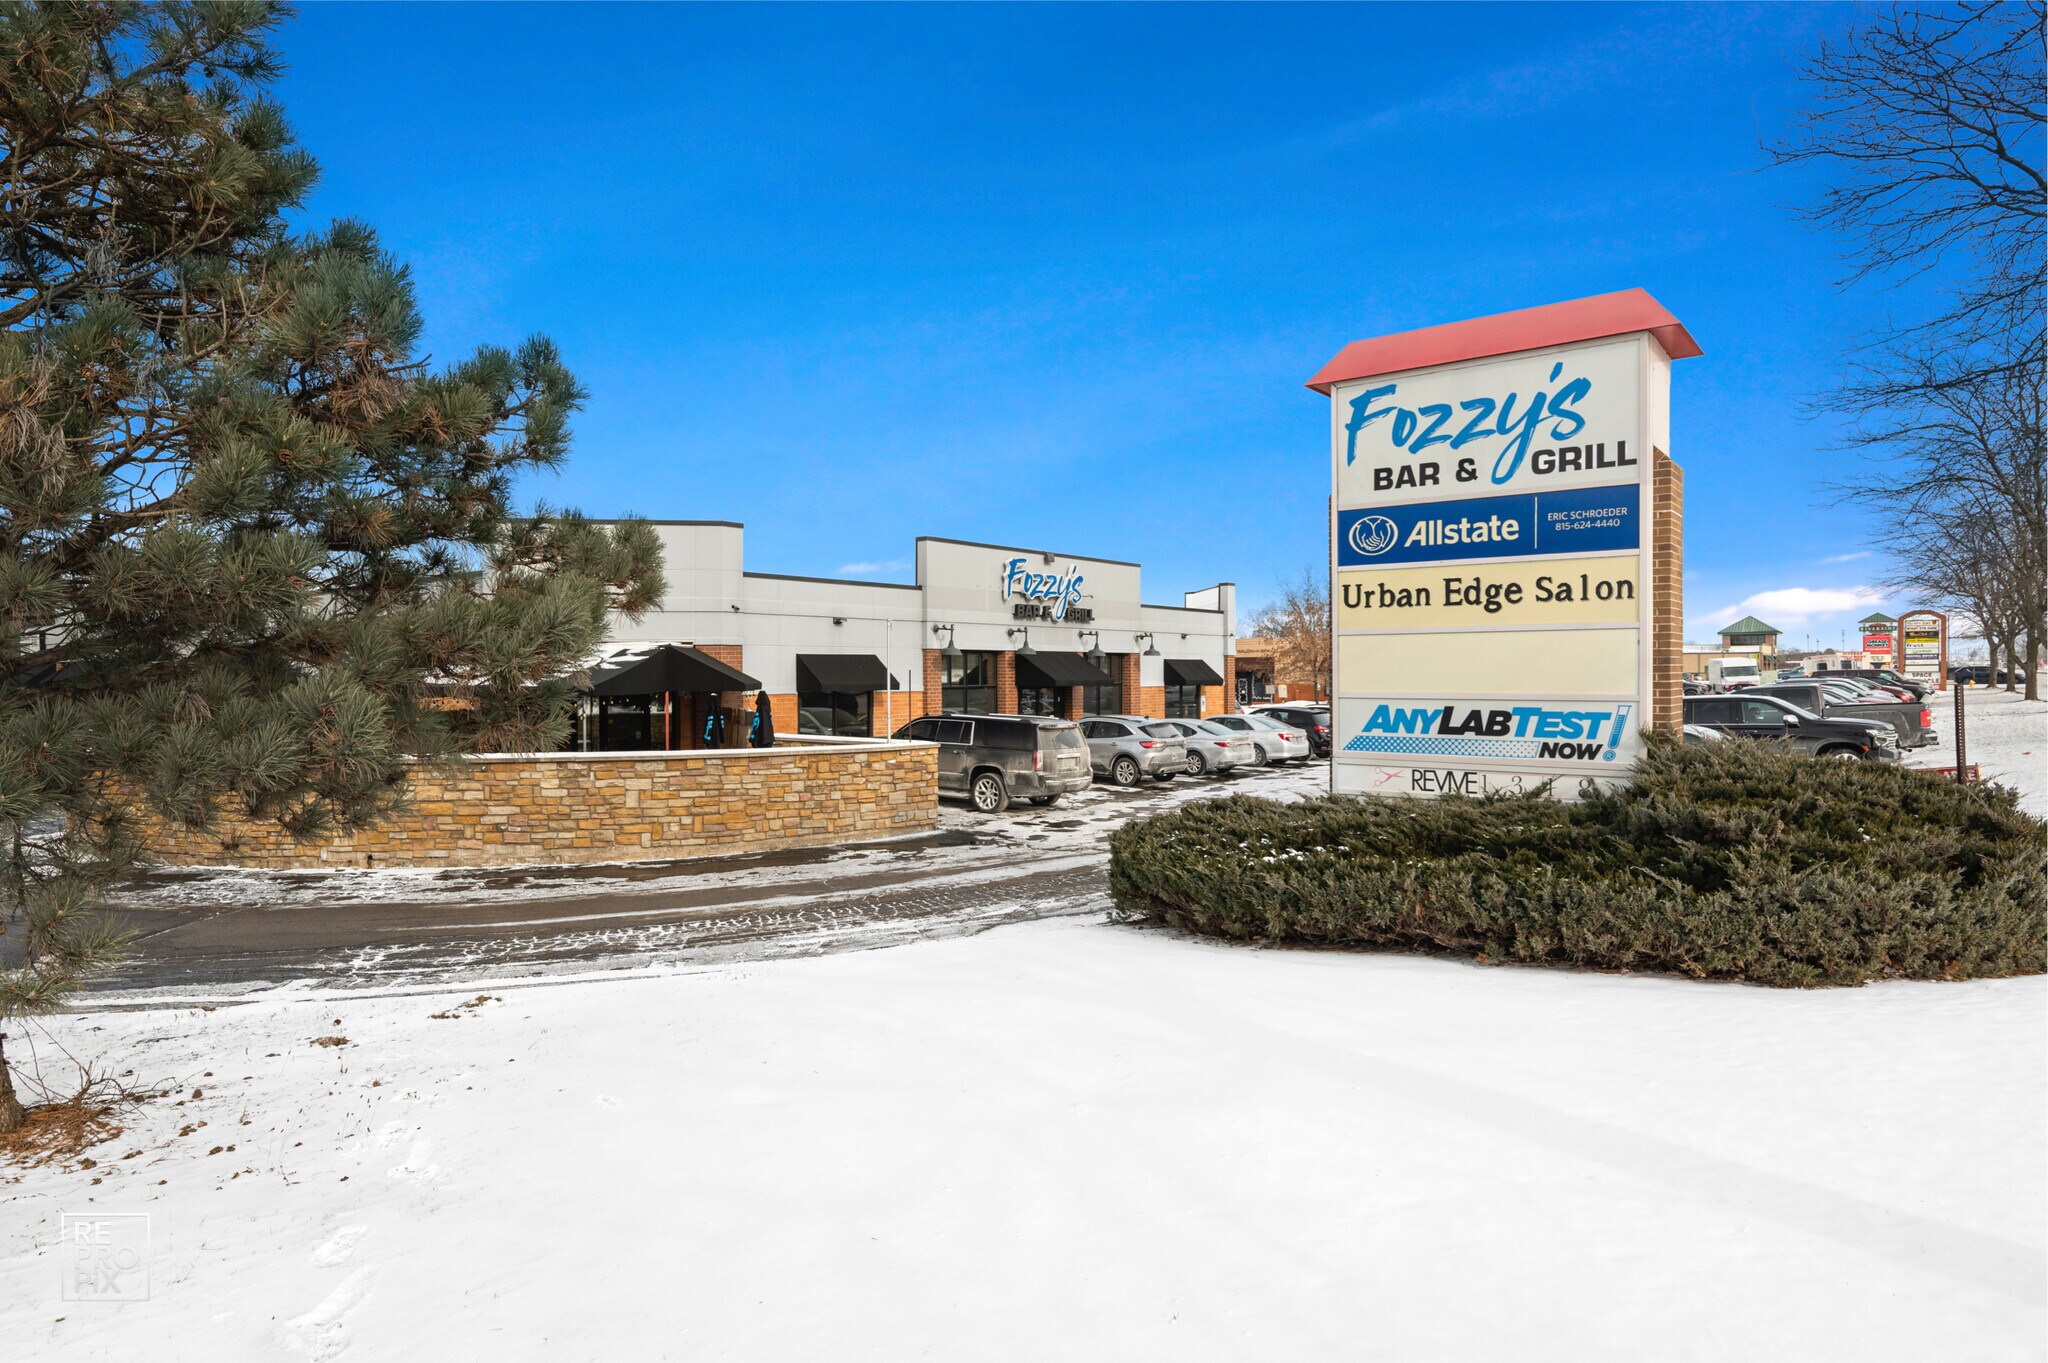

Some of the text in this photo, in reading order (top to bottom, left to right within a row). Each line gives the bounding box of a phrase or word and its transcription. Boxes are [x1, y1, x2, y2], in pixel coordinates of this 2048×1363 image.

[1345, 362, 1592, 485] Fozzy's
[1373, 440, 1638, 491] BAR & GRILL
[1547, 507, 1628, 521] ERIC SCHROEDER
[1555, 518, 1621, 531] 815-624-4440
[1404, 515, 1520, 548] Allstate
[1006, 557, 1084, 620] Fozzy's
[1342, 574, 1635, 613] Urban Edge Salon
[1014, 604, 1095, 621] BAR & GRILL
[1538, 742, 1603, 760] NOW
[1411, 769, 1478, 794] REVIVE
